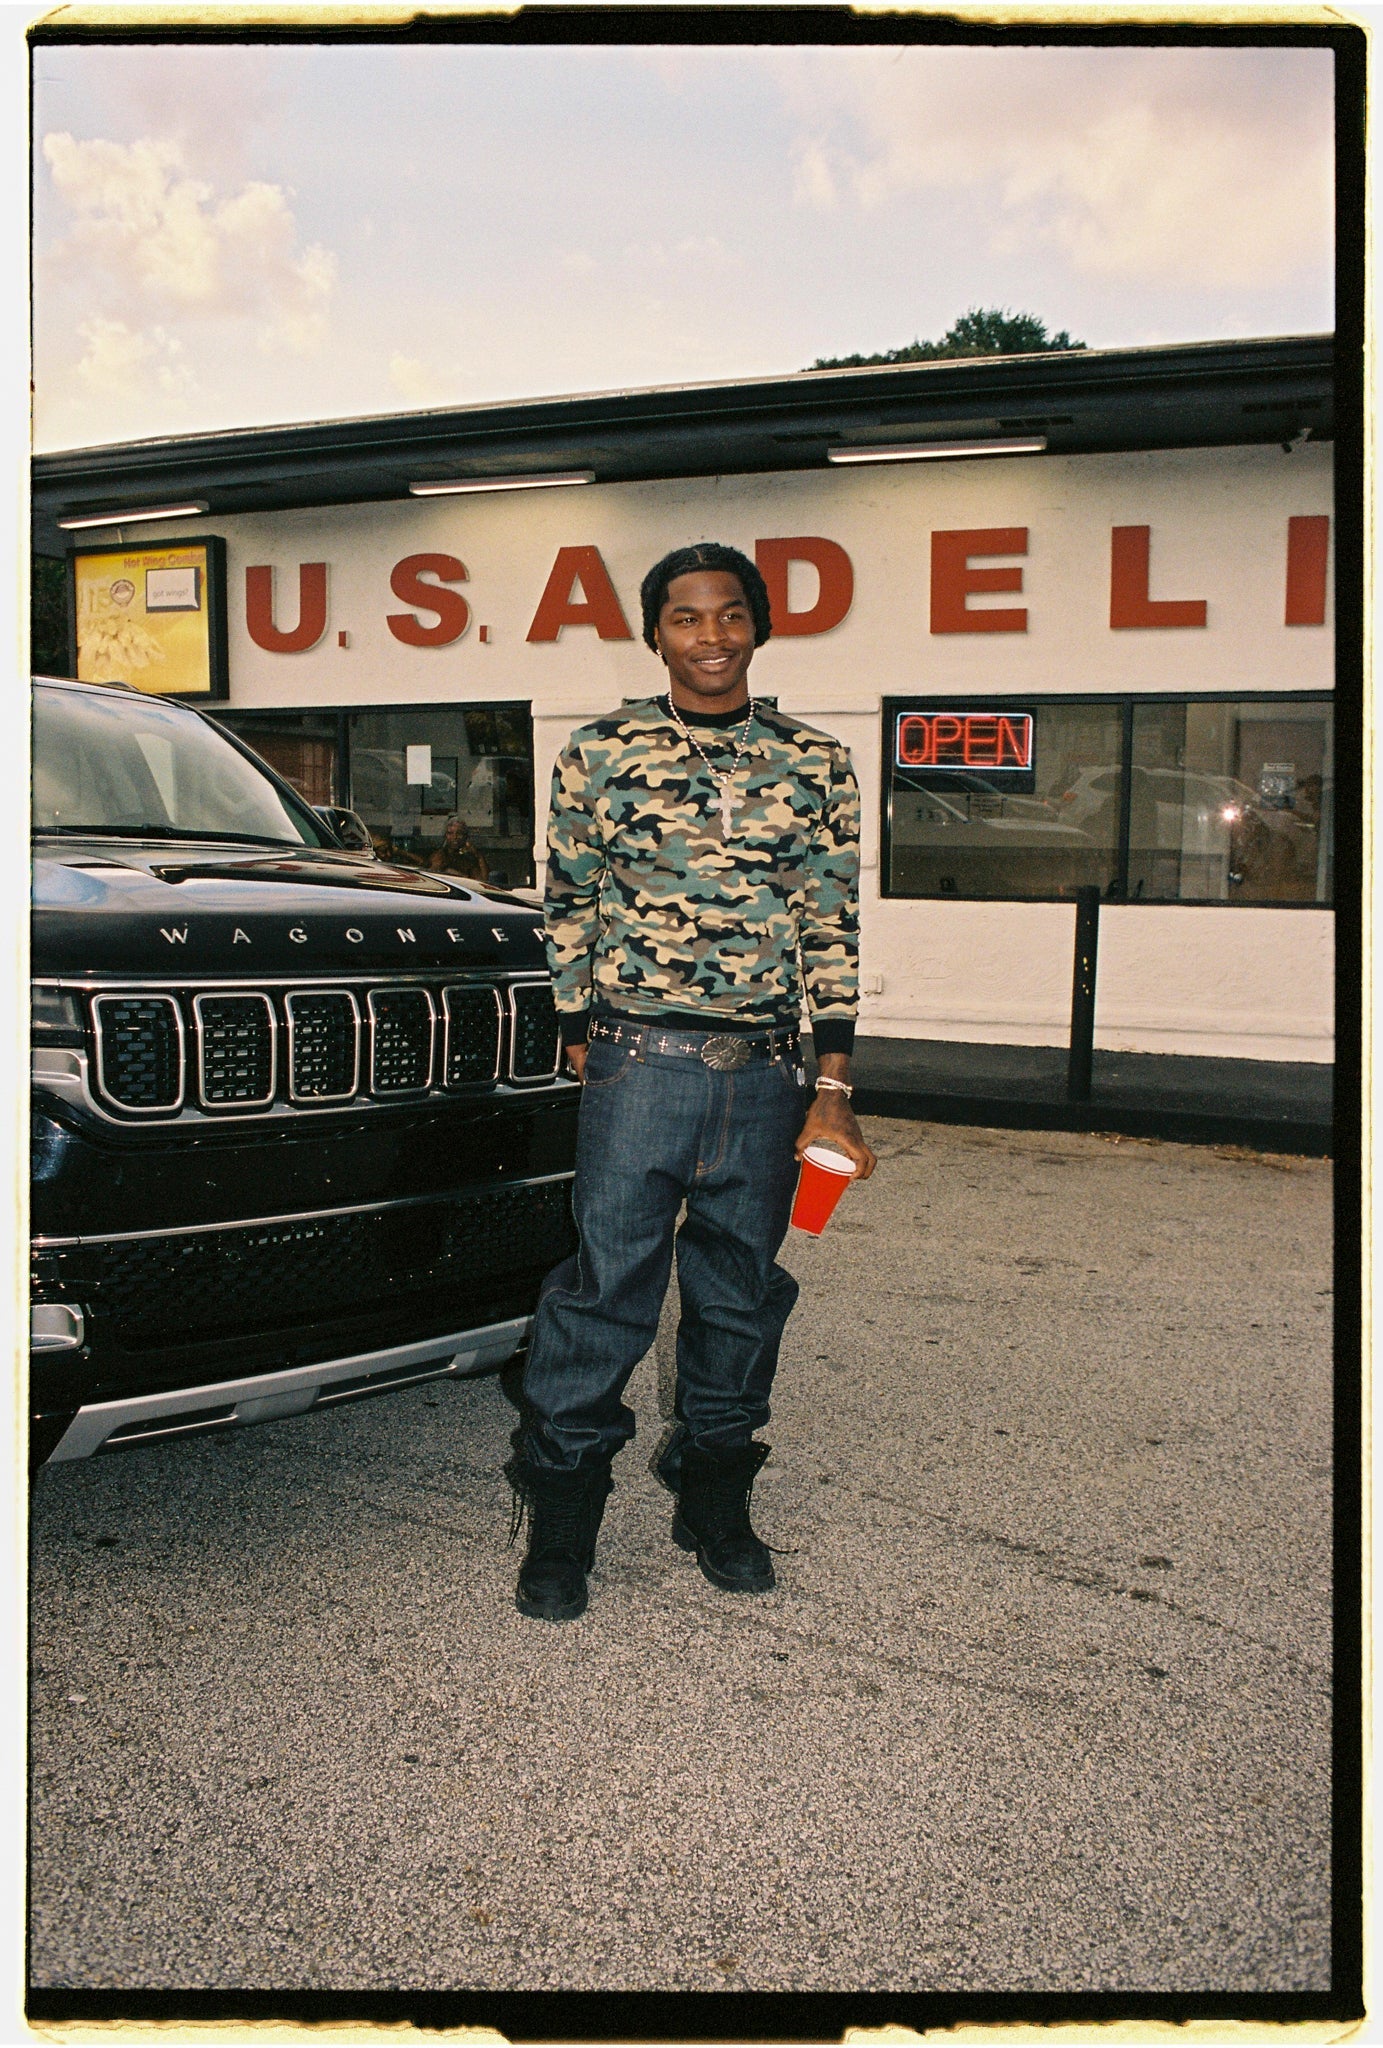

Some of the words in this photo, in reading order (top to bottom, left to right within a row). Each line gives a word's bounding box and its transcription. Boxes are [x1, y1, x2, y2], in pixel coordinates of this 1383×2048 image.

[123, 557, 139, 568] Hot
[143, 555, 165, 567] Wing
[755, 515, 1329, 638] DELI
[152, 590, 165, 599] got
[900, 716, 1029, 766] OPEN
